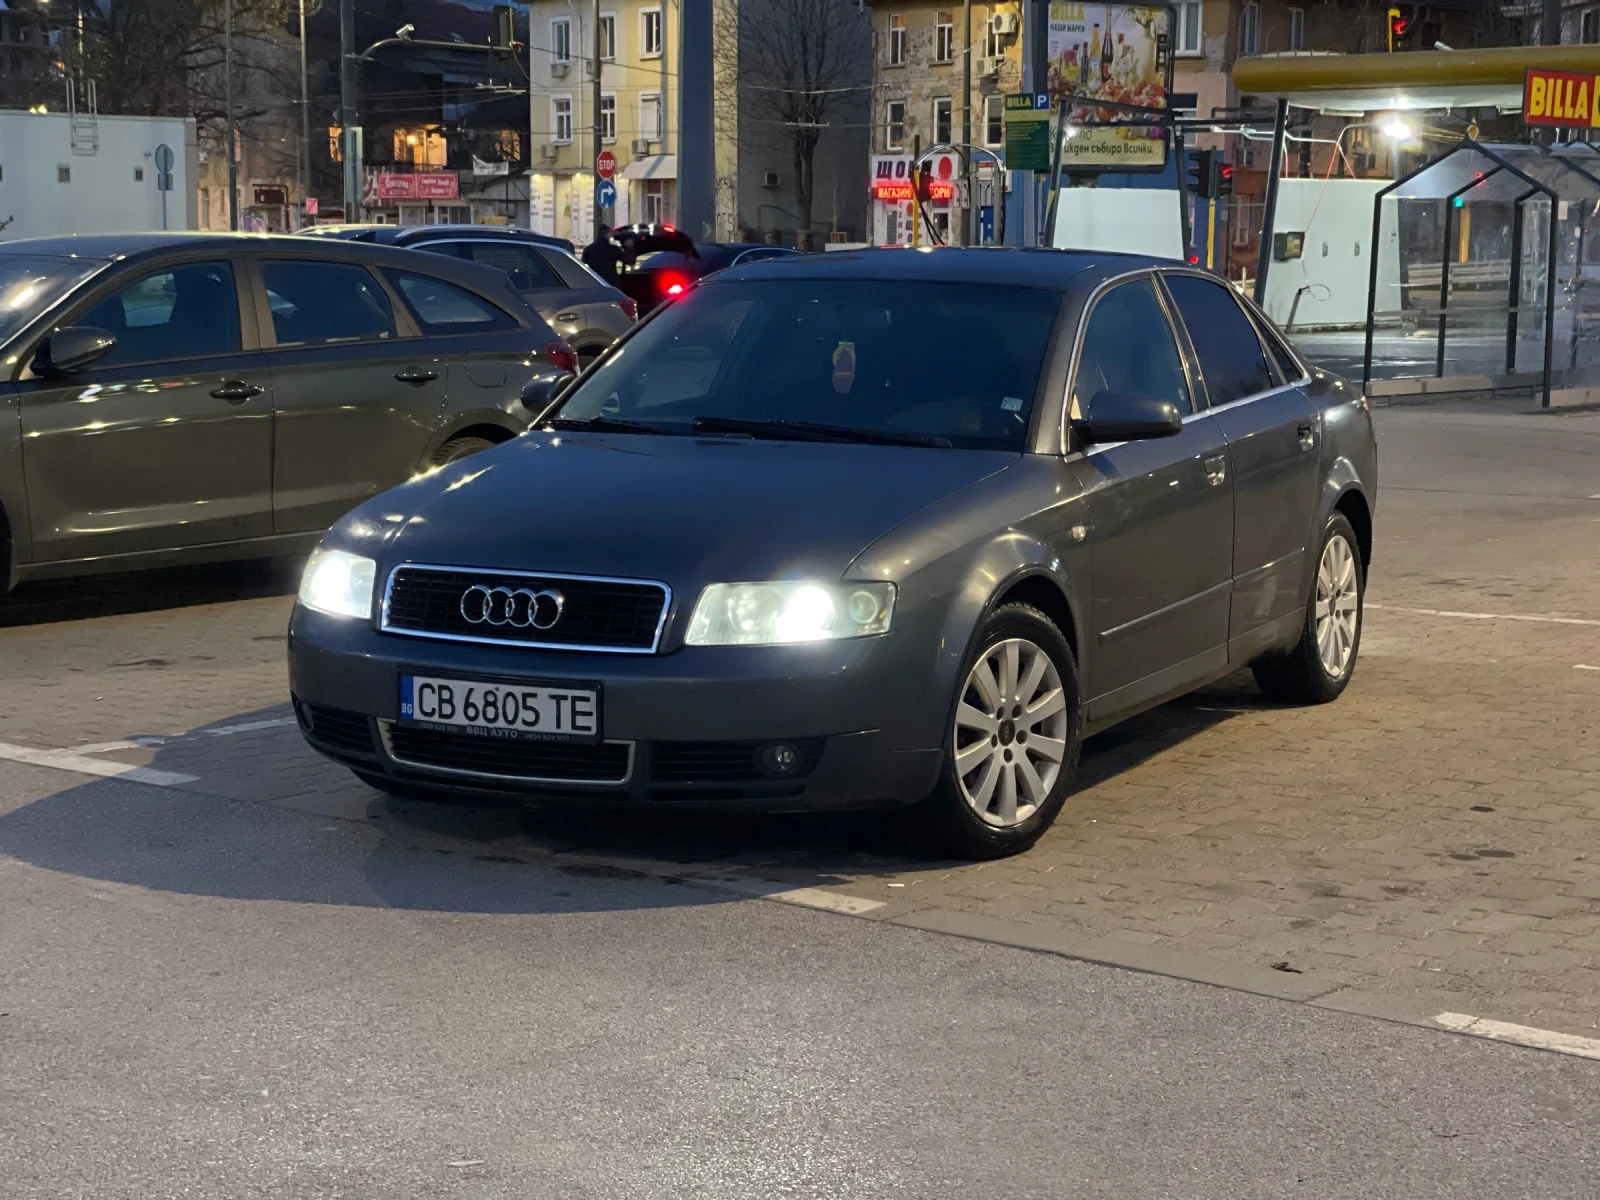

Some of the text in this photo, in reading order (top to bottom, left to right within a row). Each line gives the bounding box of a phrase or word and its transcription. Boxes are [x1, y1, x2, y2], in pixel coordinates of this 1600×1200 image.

[1050, 2, 1085, 21] BILLA
[1050, 23, 1086, 33] НАШИ МАРКИ
[1006, 95, 1047, 108] BILLA P
[1530, 76, 1588, 120] BILLA
[1091, 142, 1121, 156] събира
[1123, 142, 1155, 154] всички.
[598, 160, 615, 170] STOP
[878, 187, 912, 199] МАГАЗИН
[401, 682, 594, 732] BG CB 6805 TE
[466, 725, 488, 737] ВВЦ
[490, 728, 518, 738] АУТО
